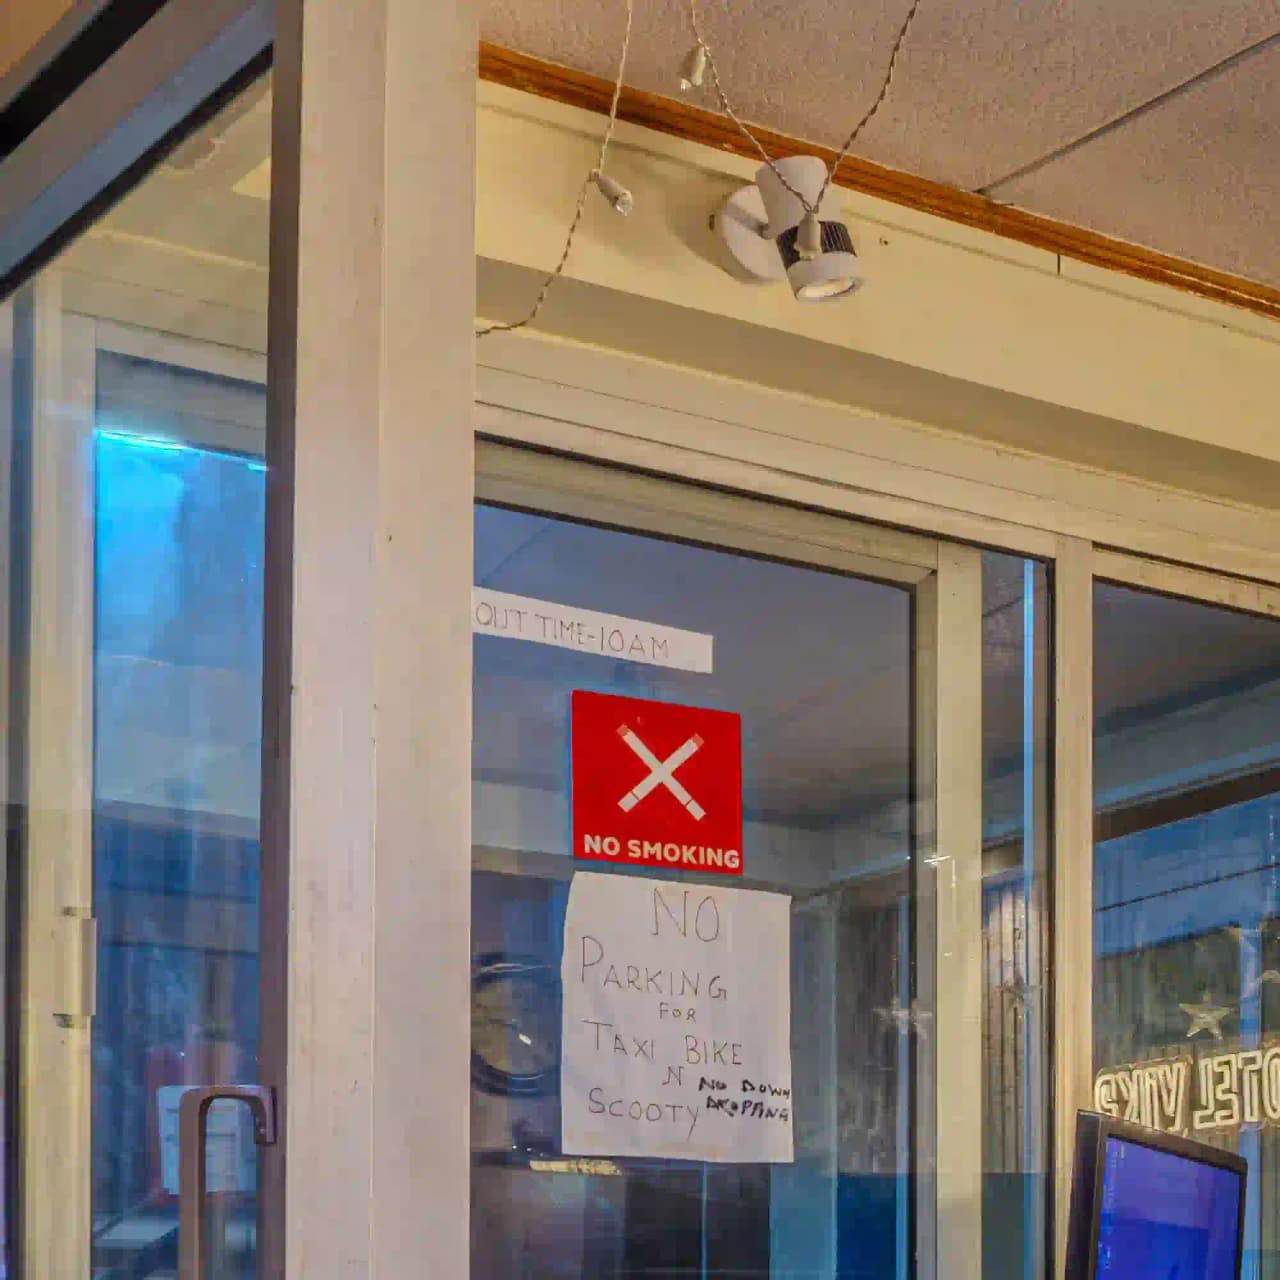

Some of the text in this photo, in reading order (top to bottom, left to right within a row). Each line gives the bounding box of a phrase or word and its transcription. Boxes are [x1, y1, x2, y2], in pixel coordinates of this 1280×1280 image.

[476, 602, 527, 632] OUT
[583, 834, 740, 869] NO SMOKING
[652, 887, 719, 942] NO
[580, 936, 727, 1001] PARKING
[659, 1002, 697, 1022] FOR
[580, 1019, 743, 1065] TAXI BIKE
[698, 1077, 726, 1091] NO
[588, 1087, 699, 1141] SCOOTY
